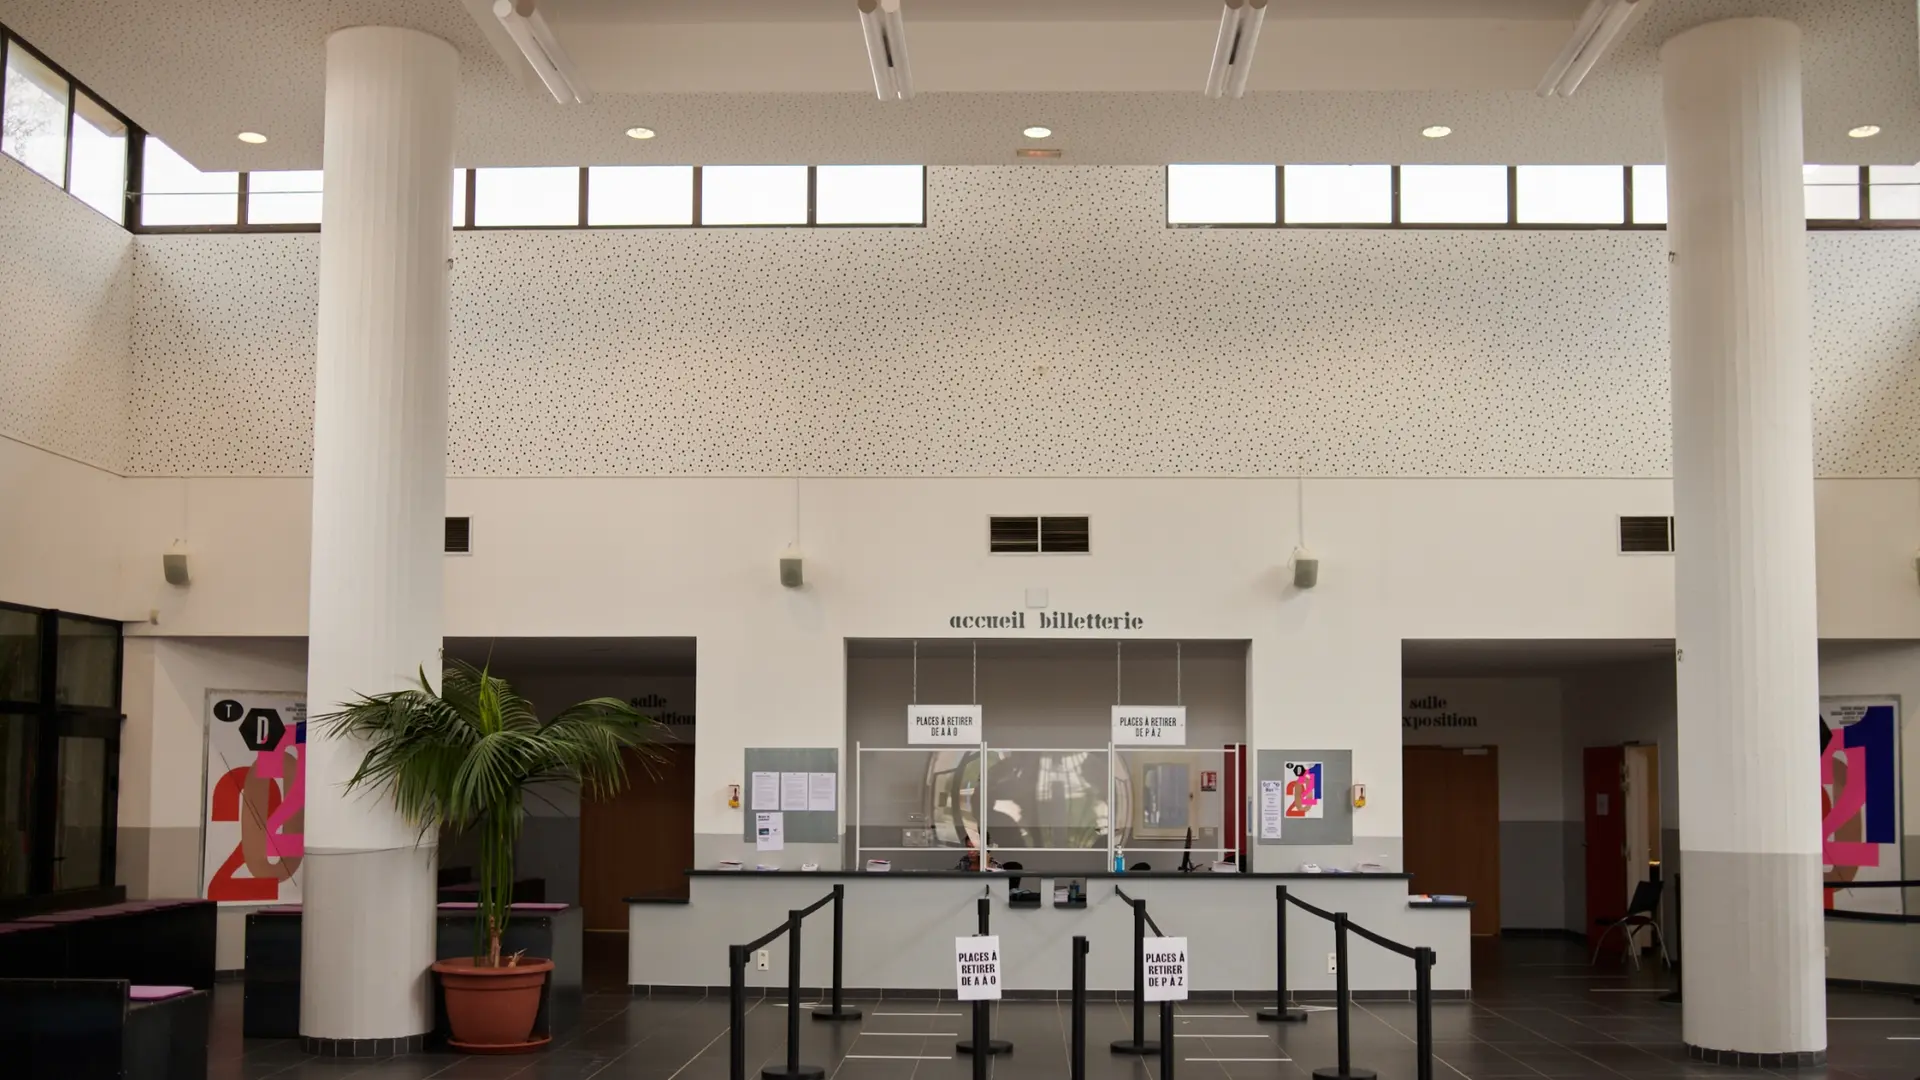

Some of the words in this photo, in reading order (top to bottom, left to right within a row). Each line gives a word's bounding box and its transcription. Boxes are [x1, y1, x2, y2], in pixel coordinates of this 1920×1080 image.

[949, 611, 1025, 629] accueil
[1040, 611, 1144, 630] billetterie
[630, 694, 667, 708] salle
[1409, 695, 1447, 709] salle
[225, 703, 232, 719] T
[916, 716, 939, 726] PLACES
[941, 714, 946, 726] À
[947, 716, 973, 726] RETIRER
[1120, 717, 1143, 727] PLACES
[1145, 715, 1149, 726] À
[1151, 717, 1177, 727] RETIRER
[1402, 712, 1478, 730] xposition
[256, 716, 268, 744] D
[931, 727, 939, 736] DE
[1136, 728, 1143, 737] DE
[1145, 728, 1150, 737] P
[1157, 728, 1161, 737] Z
[958, 952, 989, 962] PLACES
[992, 949, 997, 961] À
[1145, 953, 1177, 963] PLACES
[1179, 950, 1185, 962] À
[961, 963, 995, 974] RETIRER
[1148, 964, 1183, 975] RETIRER
[961, 976, 971, 986] DE
[974, 976, 980, 986] A
[982, 974, 988, 986] À
[990, 975, 996, 985] O
[1148, 977, 1159, 987] DE
[1161, 977, 1167, 987] P
[1170, 975, 1176, 986] À
[1178, 976, 1183, 986] Z
